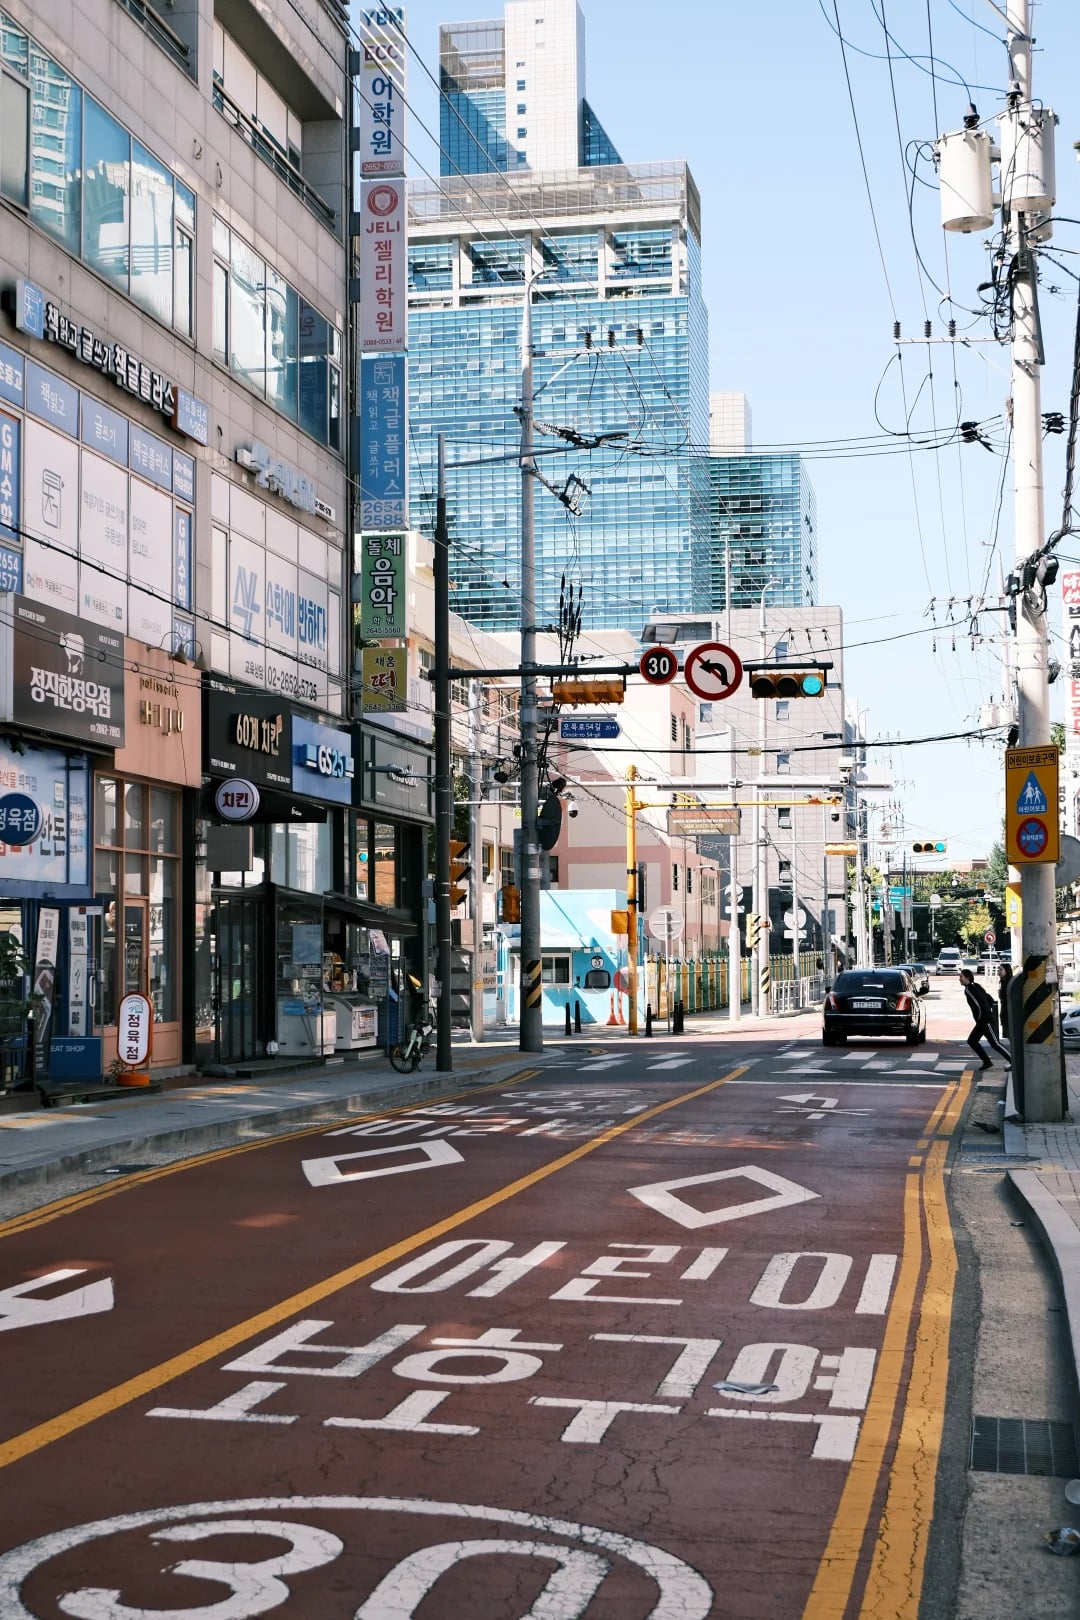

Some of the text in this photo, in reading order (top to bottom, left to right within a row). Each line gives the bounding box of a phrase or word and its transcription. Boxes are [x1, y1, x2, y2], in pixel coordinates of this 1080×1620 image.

[363, 8, 403, 26] YBM
[365, 46, 399, 61] ECC
[370, 77, 395, 155] 어학원
[366, 221, 400, 234] JELI
[374, 240, 394, 333] 젤리학원
[45, 301, 175, 419] 책읽고 글쓰기 책글플러스
[94, 414, 117, 448] 글쓰기
[367, 389, 380, 479] 책읽고 글쓰기
[382, 386, 403, 496] 책글플러스
[363, 501, 403, 514] 2654
[363, 514, 404, 526] 2588
[366, 538, 400, 556] 돌체
[369, 558, 397, 616] 음악
[298, 595, 327, 652] 반하다
[648, 657, 670, 675] 30
[30, 667, 111, 719] 정직한정육점
[318, 744, 344, 781] GS25
[1009, 751, 1056, 768] 어린이보호구역
[221, 791, 249, 808] 치킨
[1018, 804, 1047, 814] 어린이보호
[65, 1045, 86, 1055] SHOP
[370, 1239, 898, 1314] 어린이
[145, 1319, 877, 1461] 보호구역
